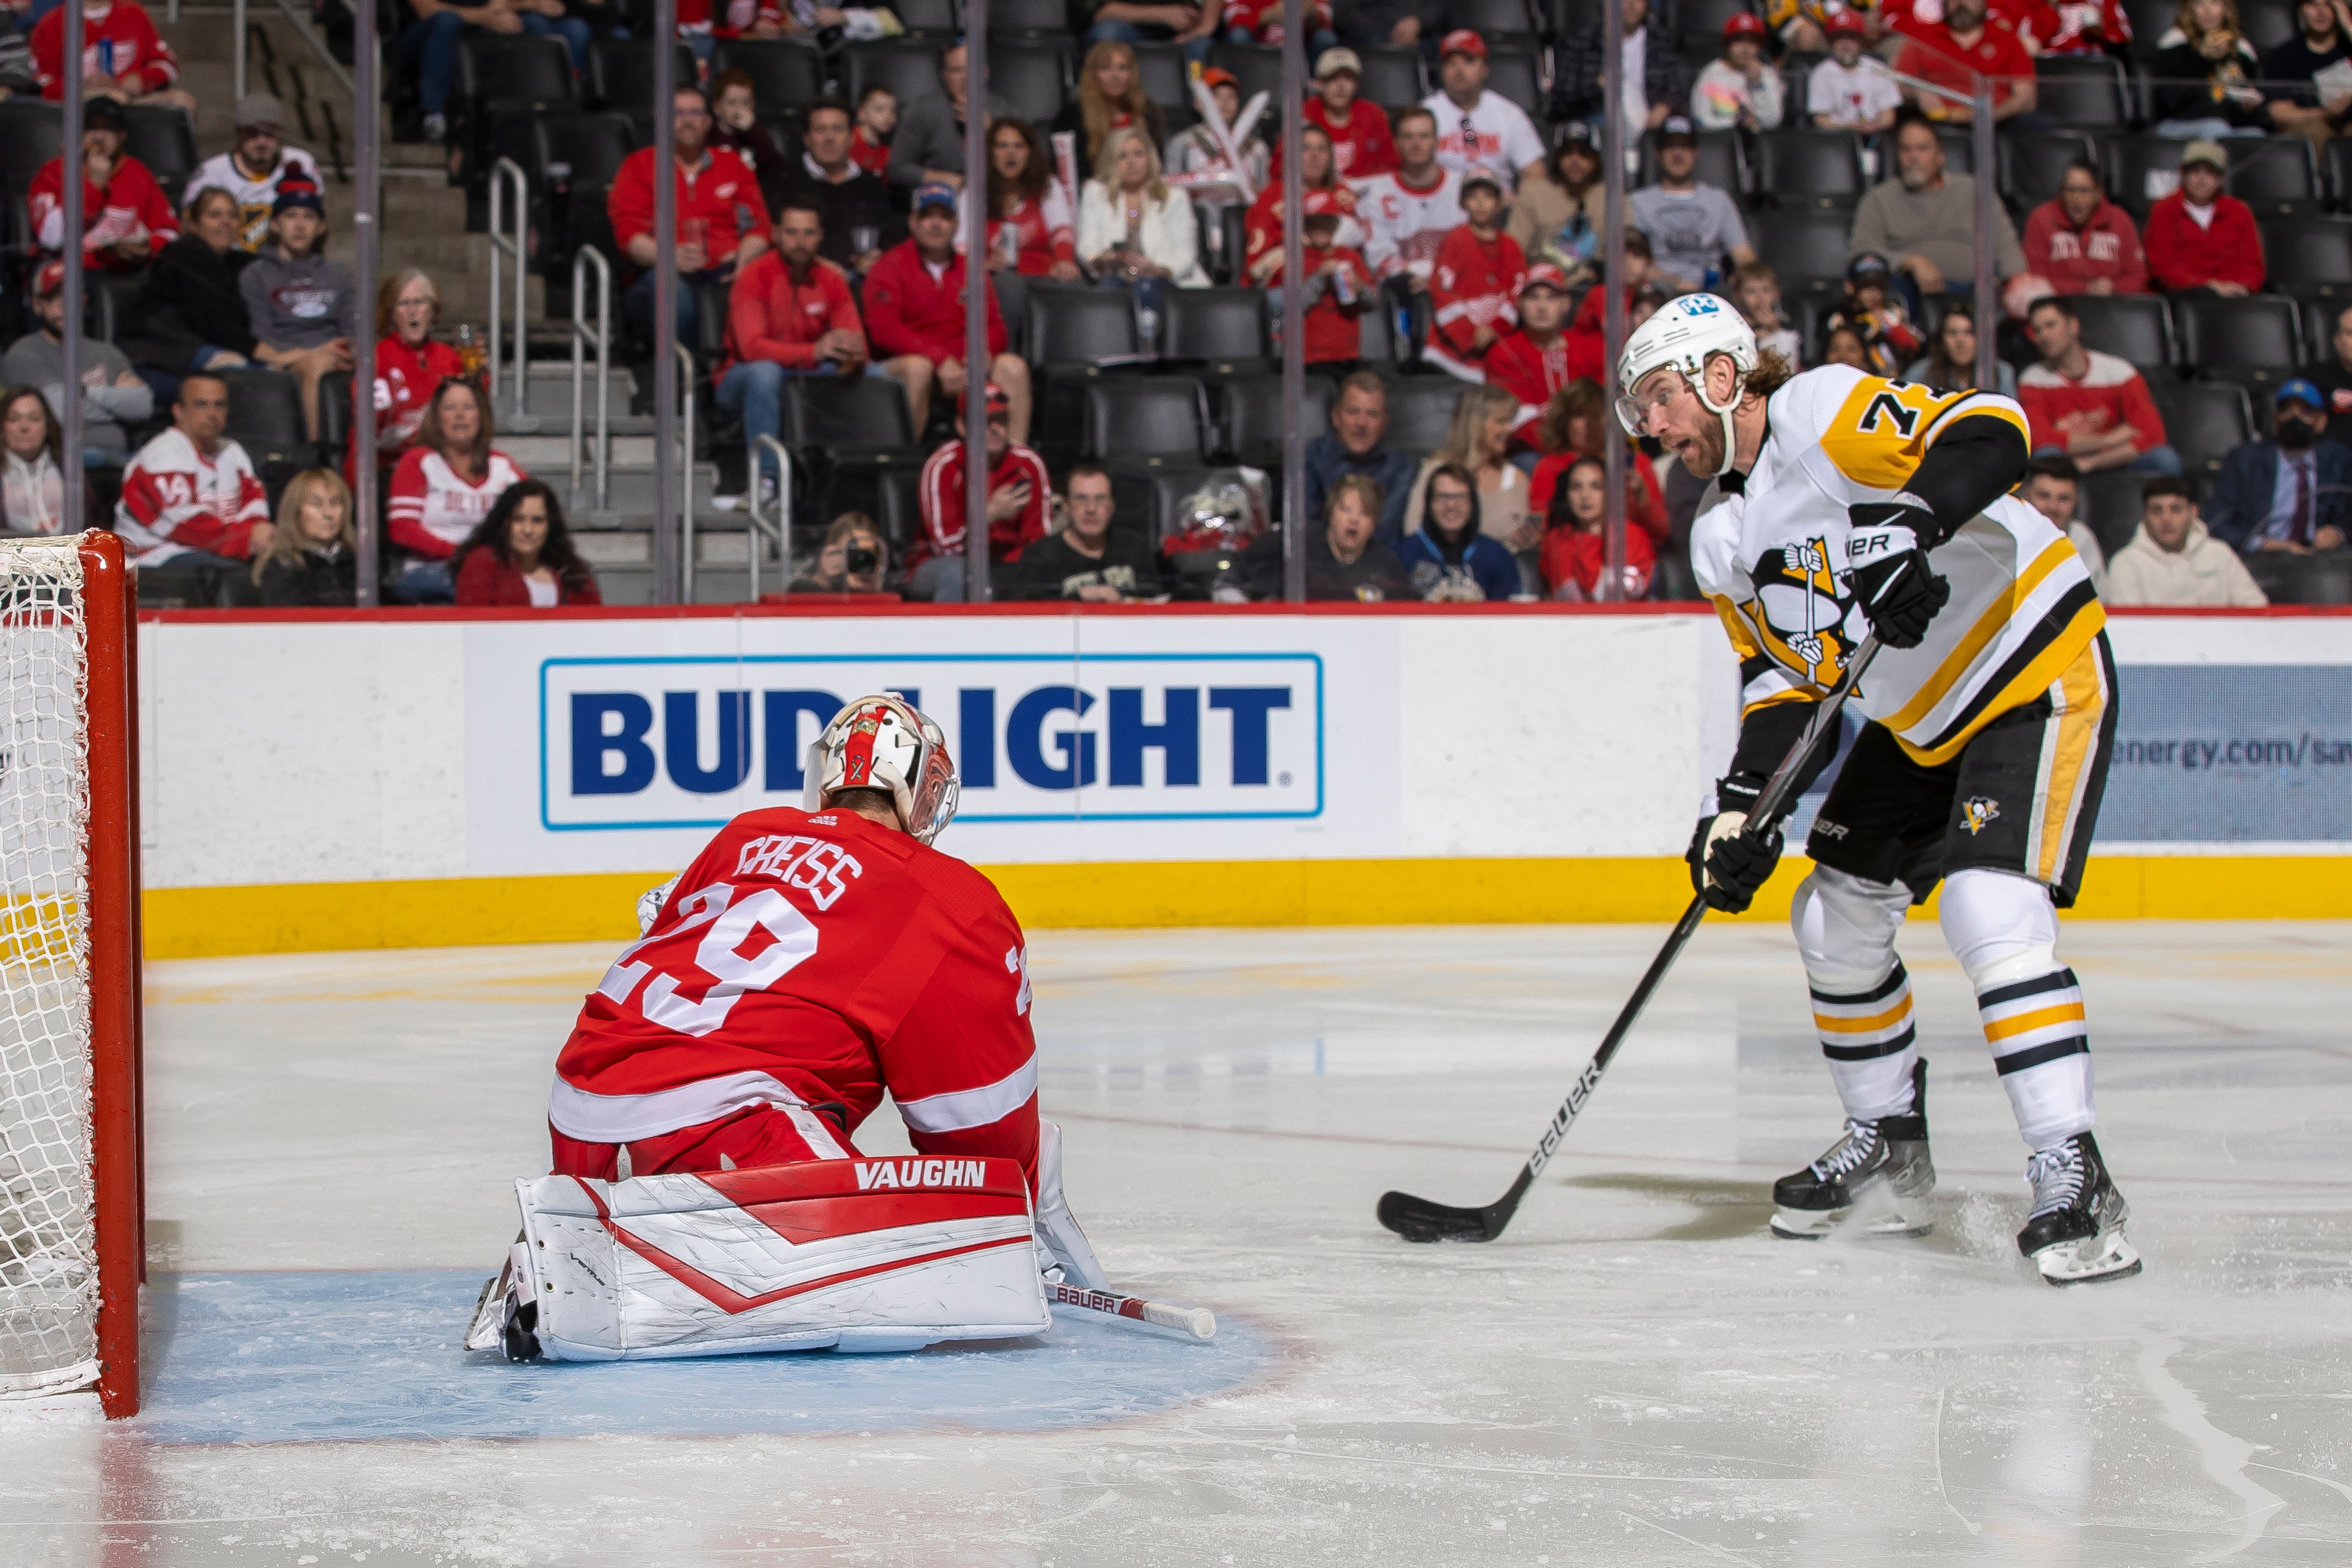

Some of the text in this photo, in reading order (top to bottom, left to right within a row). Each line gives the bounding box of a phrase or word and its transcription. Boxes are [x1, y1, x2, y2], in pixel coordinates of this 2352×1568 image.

[571, 685, 1292, 796] BUD IGHT
[731, 835, 863, 912] GREISS
[597, 882, 819, 1037] 29
[854, 1159, 986, 1190] VAUGHN
